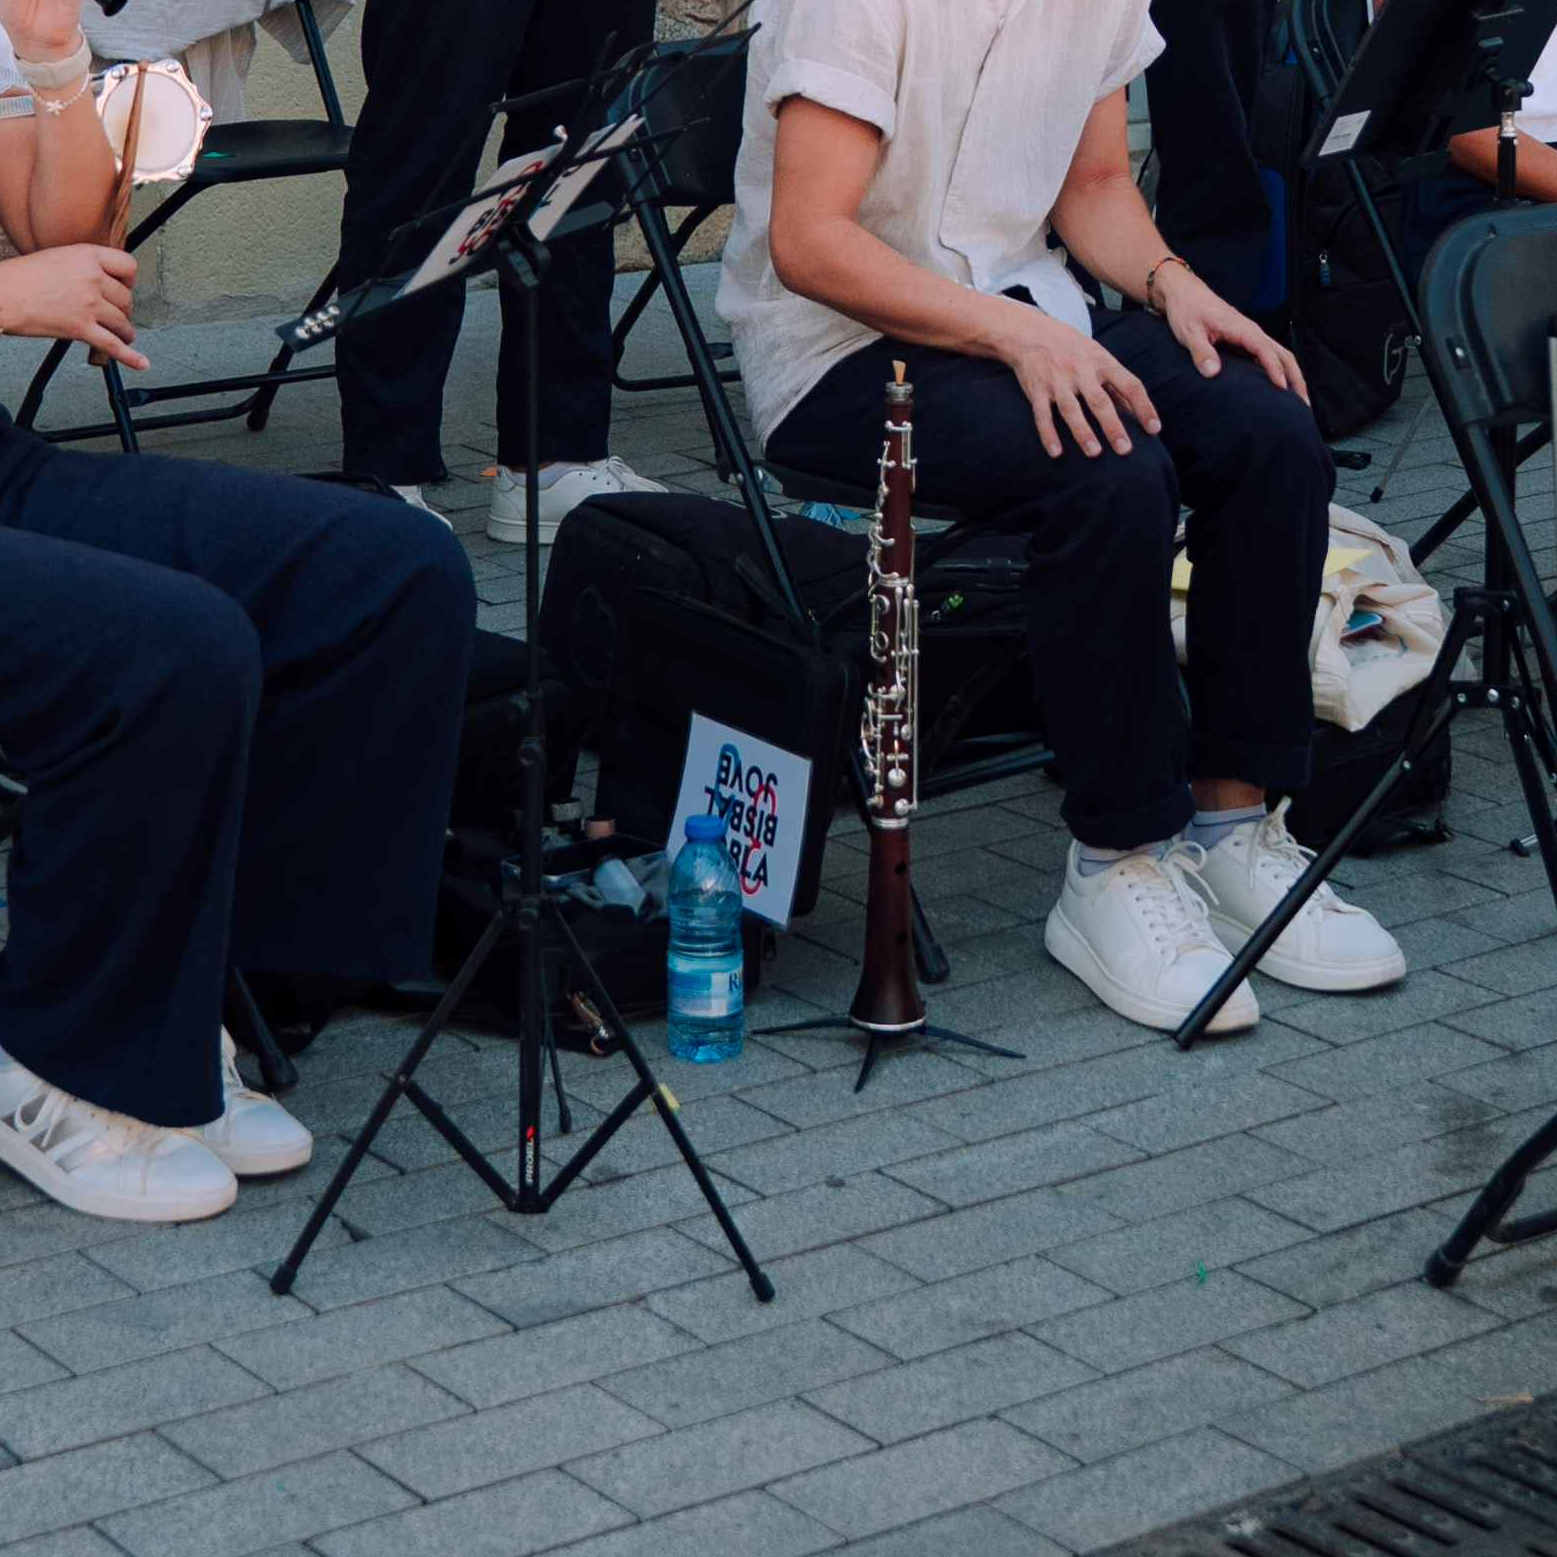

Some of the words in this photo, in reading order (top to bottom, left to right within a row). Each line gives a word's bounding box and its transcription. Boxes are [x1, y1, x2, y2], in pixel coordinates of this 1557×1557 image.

[716, 752, 778, 803] JOVE
[704, 786, 778, 848] BISBAL
[729, 839, 769, 889] BLA
[526, 1137, 534, 1185] PROEL
